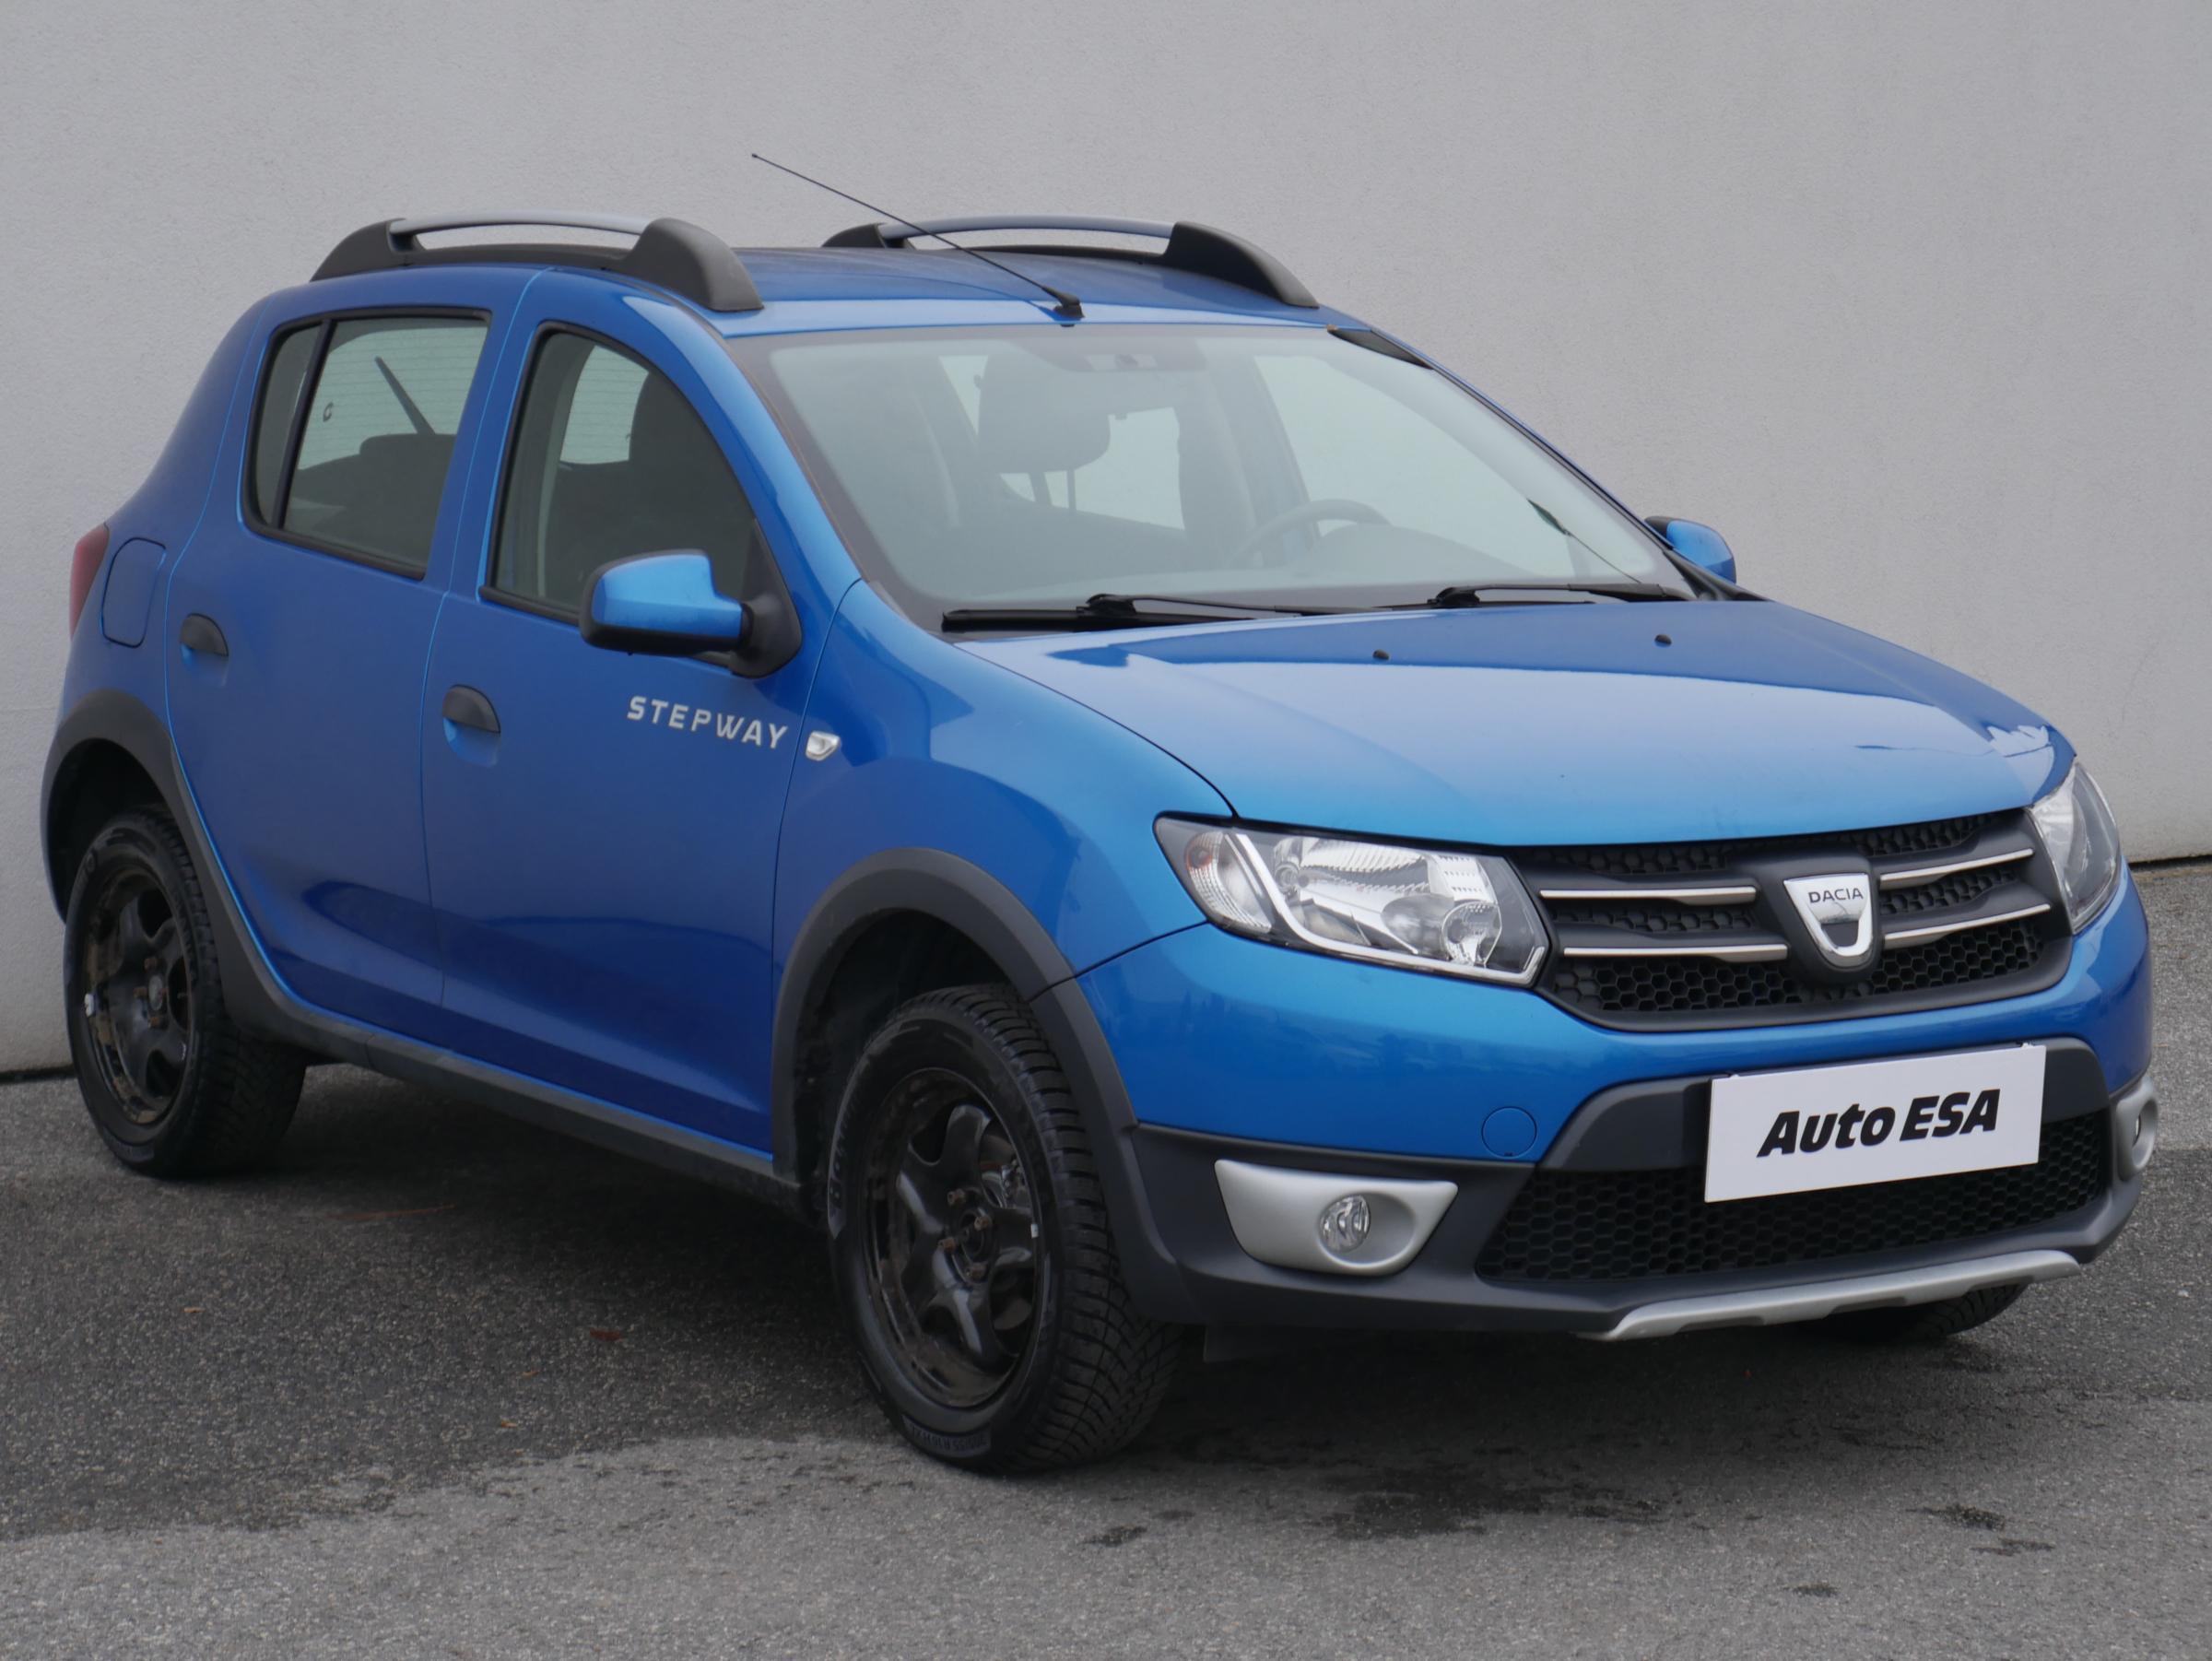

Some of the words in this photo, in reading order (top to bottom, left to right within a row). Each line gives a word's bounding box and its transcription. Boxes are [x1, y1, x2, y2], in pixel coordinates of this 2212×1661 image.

[627, 695, 788, 749] STEPWAY
[1808, 888, 1864, 903] DACIA
[1756, 1103, 1895, 1158] Auto
[1899, 1089, 2001, 1142] ESA
